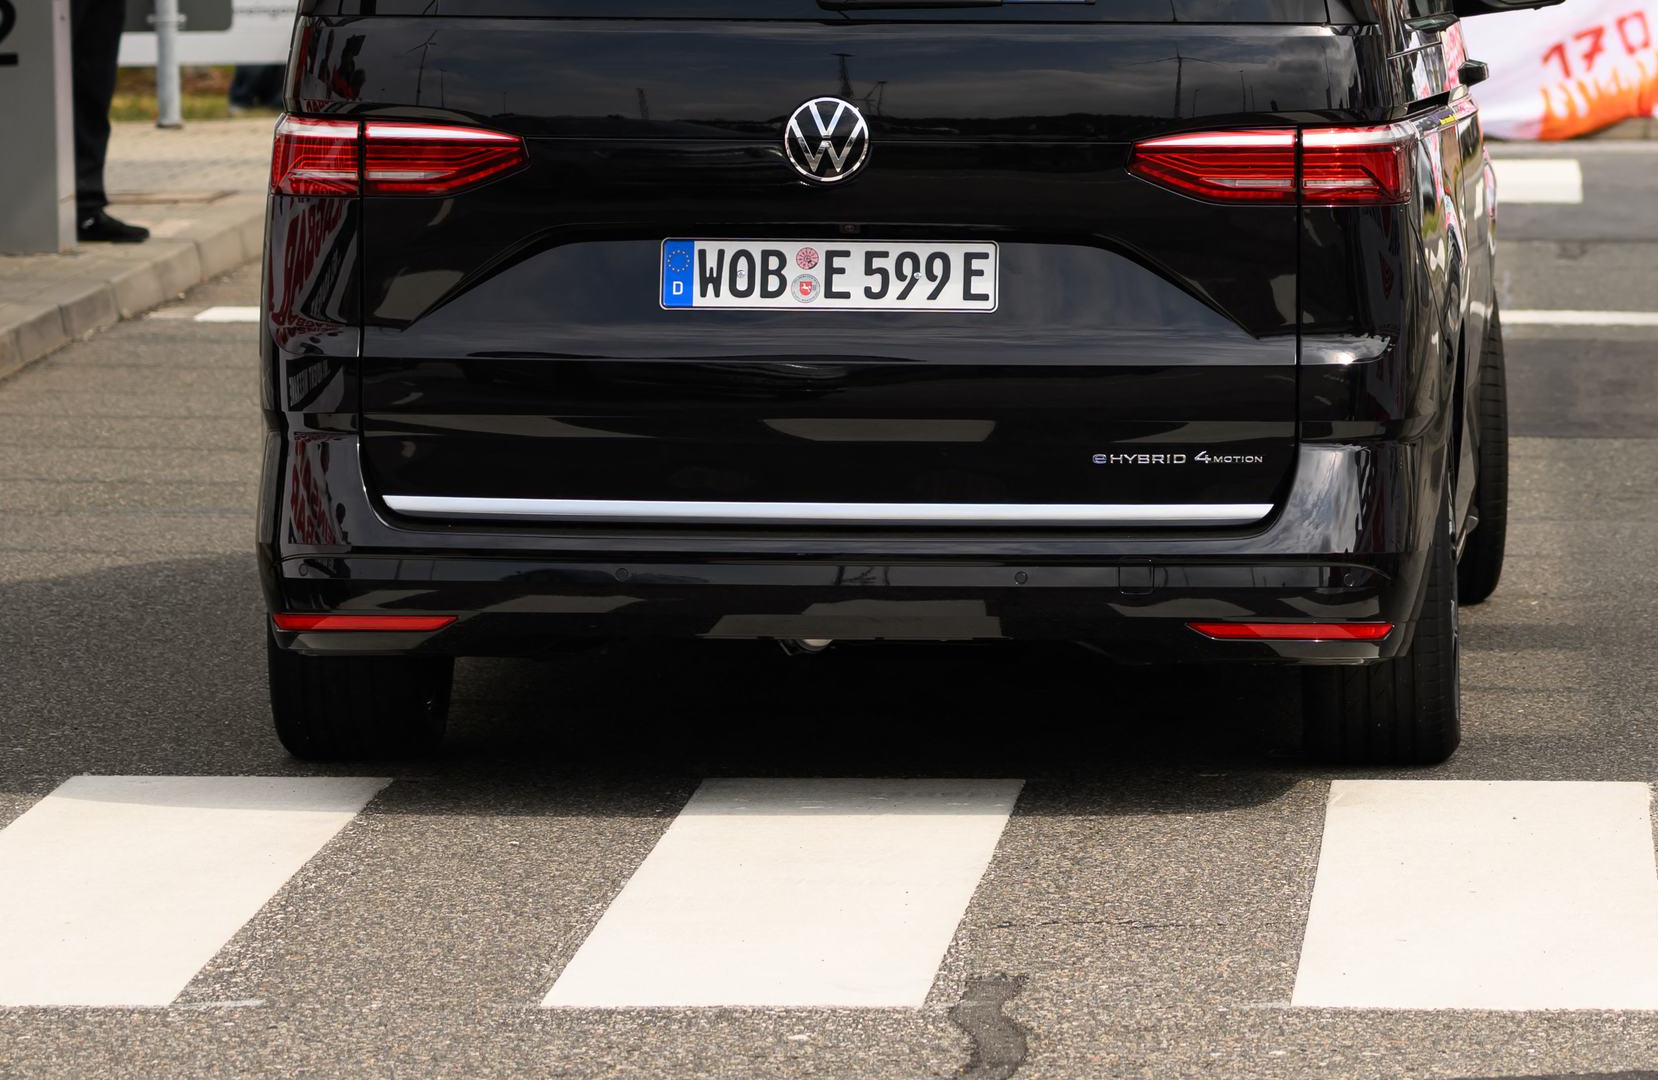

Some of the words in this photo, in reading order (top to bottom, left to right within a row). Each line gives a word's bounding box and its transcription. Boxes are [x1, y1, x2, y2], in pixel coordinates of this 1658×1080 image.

[697, 248, 788, 299] WOB
[672, 281, 684, 296] D
[1194, 450, 1264, 464] 4MOTION
